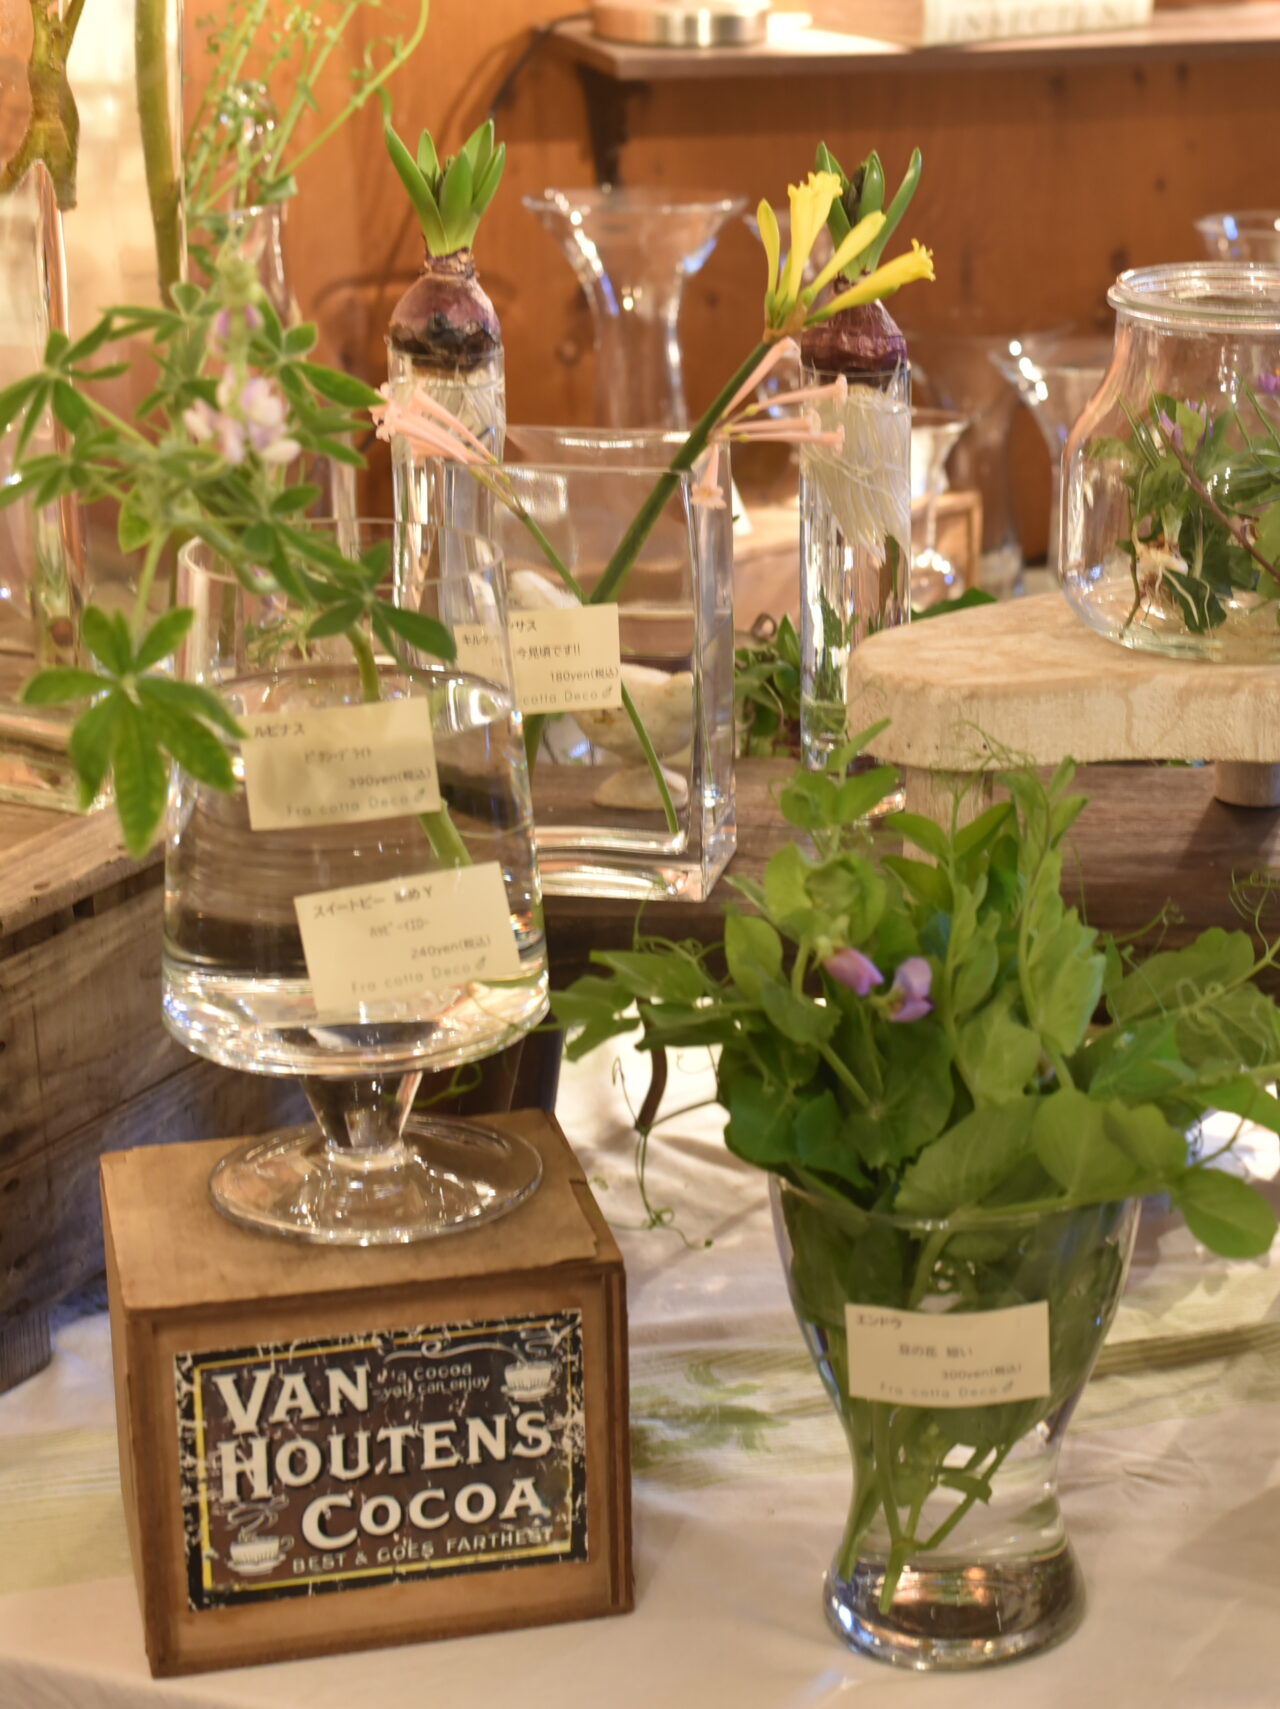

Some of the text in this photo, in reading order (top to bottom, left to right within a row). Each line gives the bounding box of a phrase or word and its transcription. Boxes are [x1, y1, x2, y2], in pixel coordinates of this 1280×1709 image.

[413, 1362, 472, 1382] cocoa
[449, 1375, 491, 1393] enjoy
[211, 1365, 371, 1436] VAN
[300, 1476, 552, 1550] COCOA
[292, 1551, 346, 1575] BEST
[446, 1526, 554, 1554] FARTHEST
